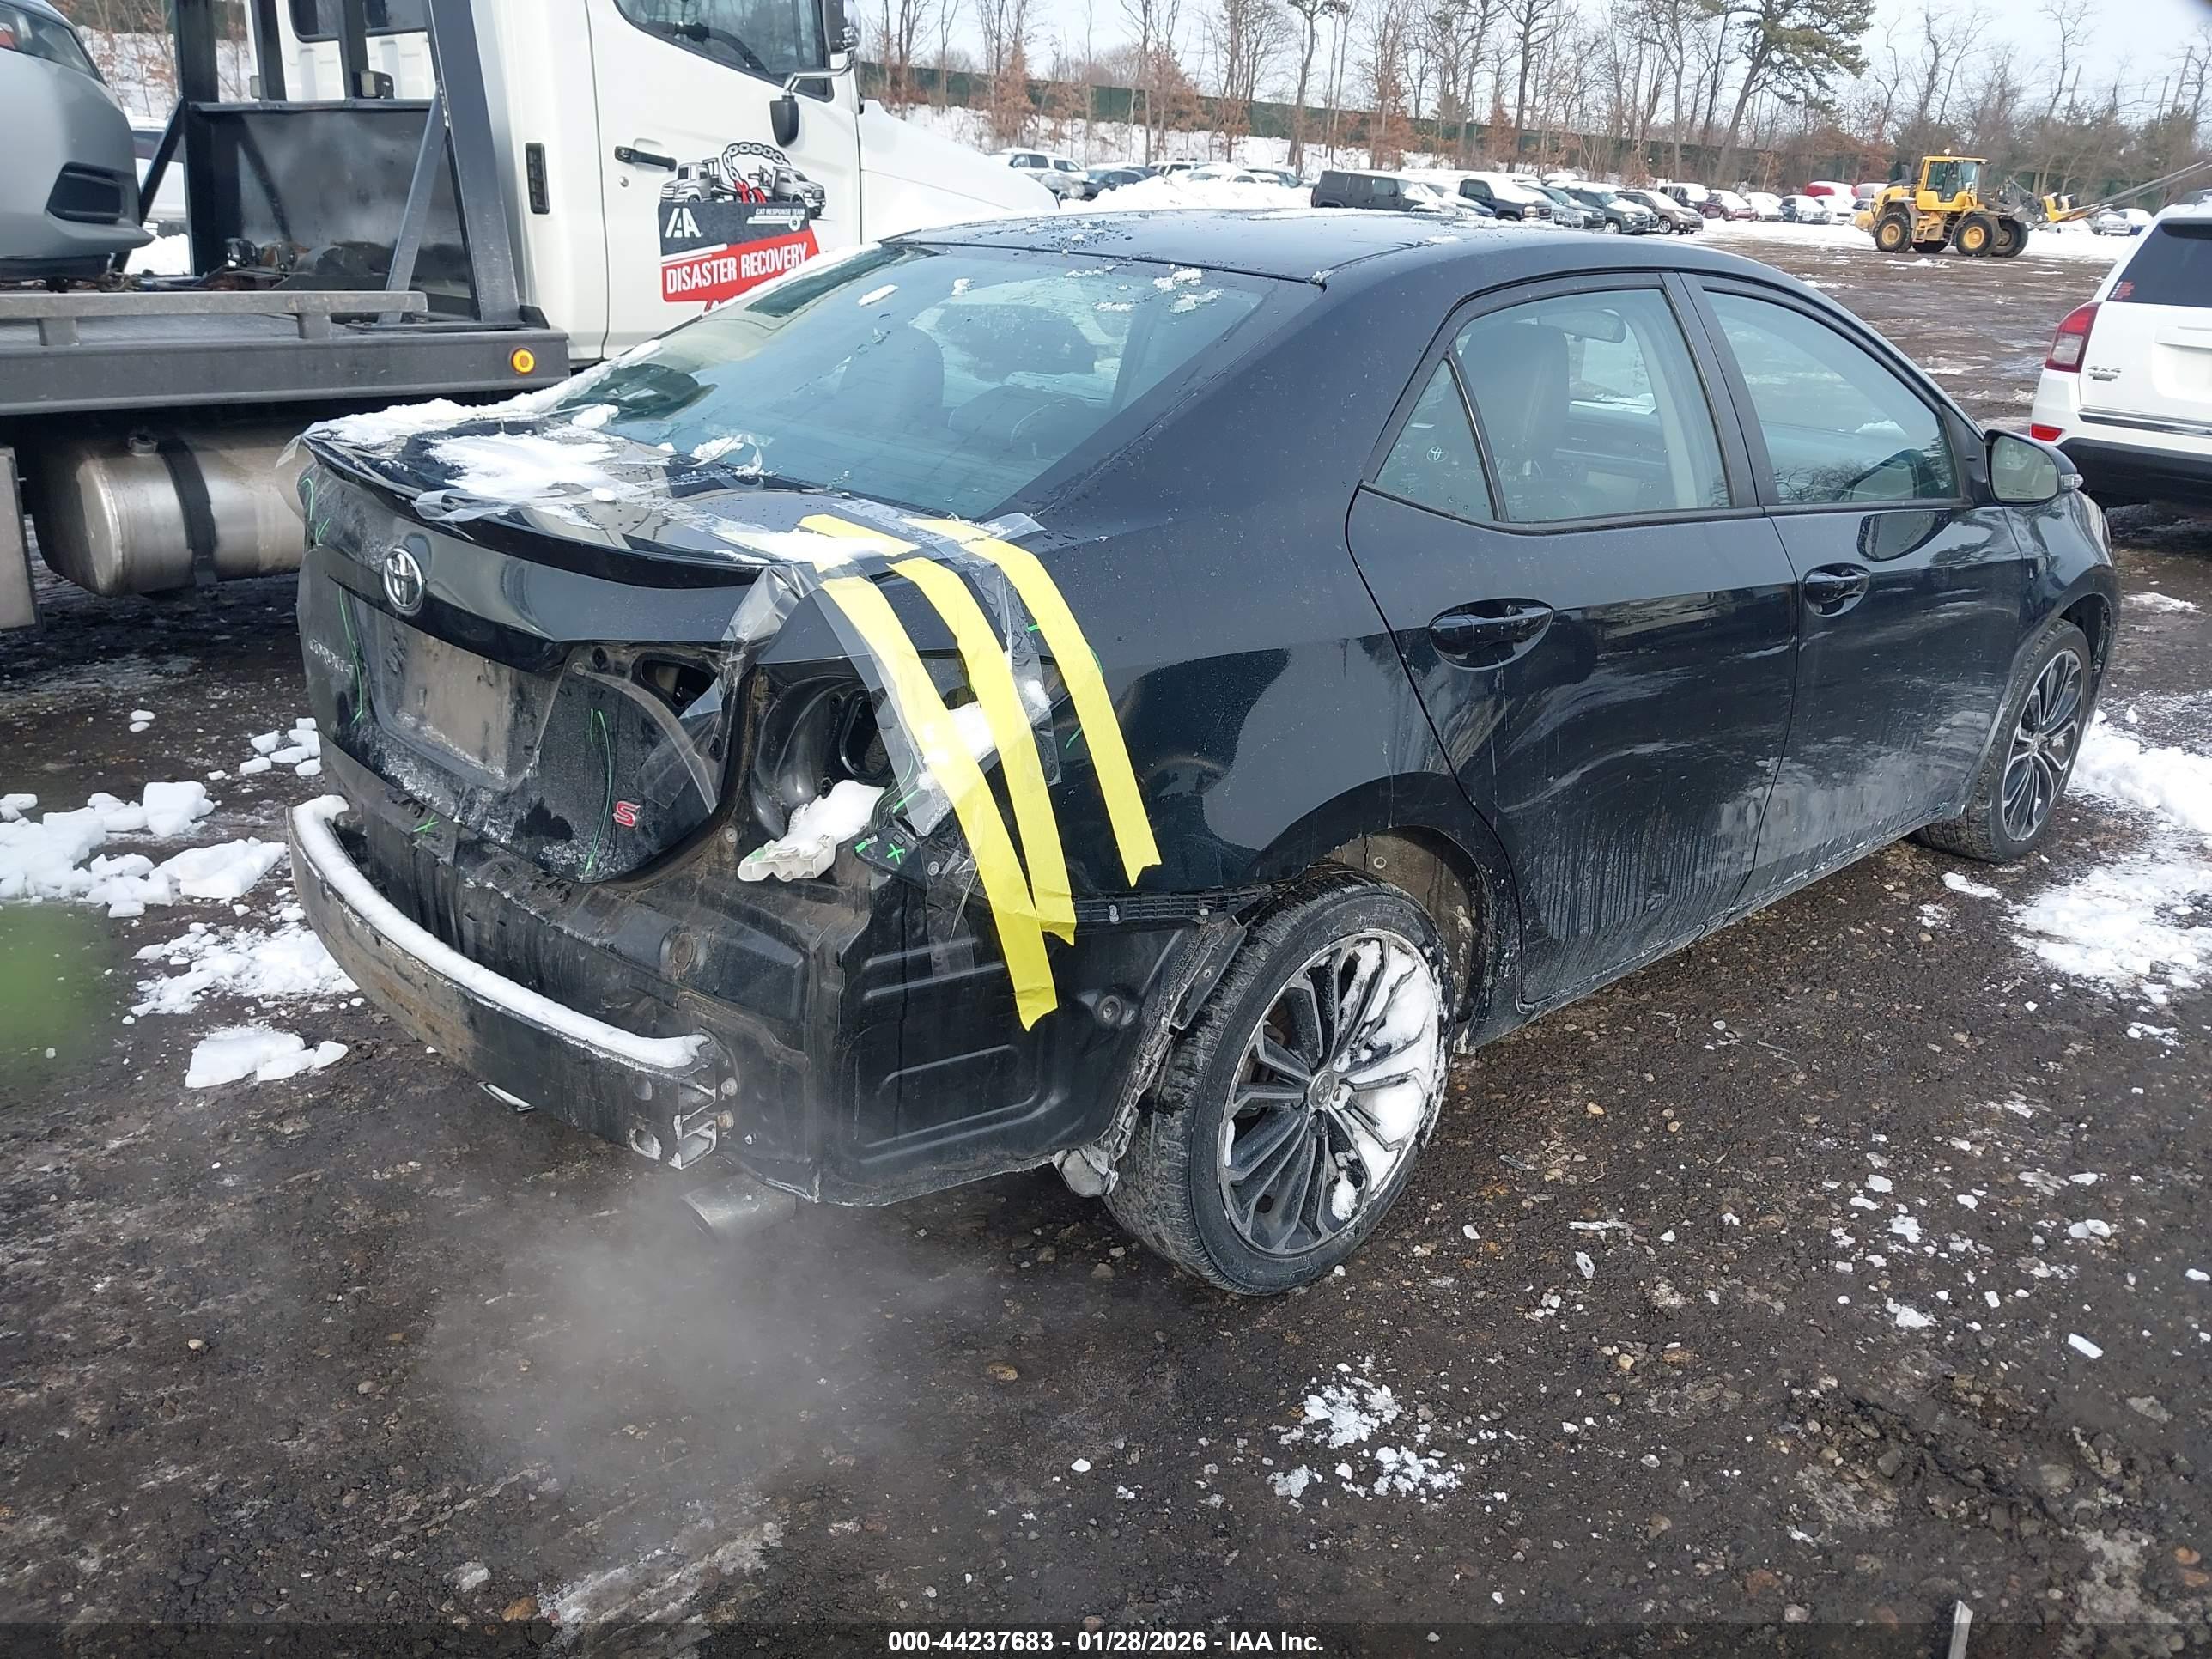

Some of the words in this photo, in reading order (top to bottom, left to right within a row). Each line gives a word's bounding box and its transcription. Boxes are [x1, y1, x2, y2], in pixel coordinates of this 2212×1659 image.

[666, 256, 738, 295] DISASTER
[740, 241, 807, 279] RECOVERY
[612, 800, 641, 828] S
